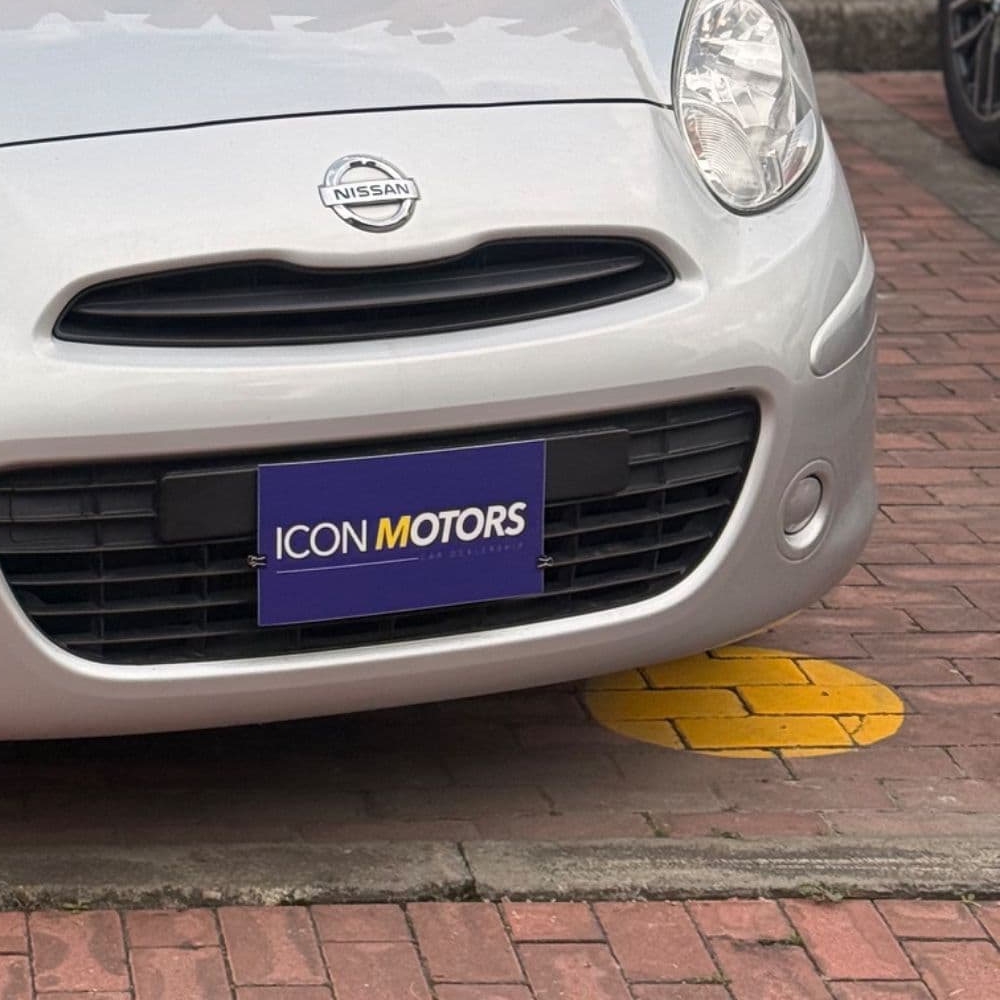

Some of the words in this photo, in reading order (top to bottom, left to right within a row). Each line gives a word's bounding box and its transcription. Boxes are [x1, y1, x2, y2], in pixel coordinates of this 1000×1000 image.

[334, 184, 410, 200] NISSAN
[276, 520, 368, 560] ICON
[375, 502, 527, 551] MOTORS
